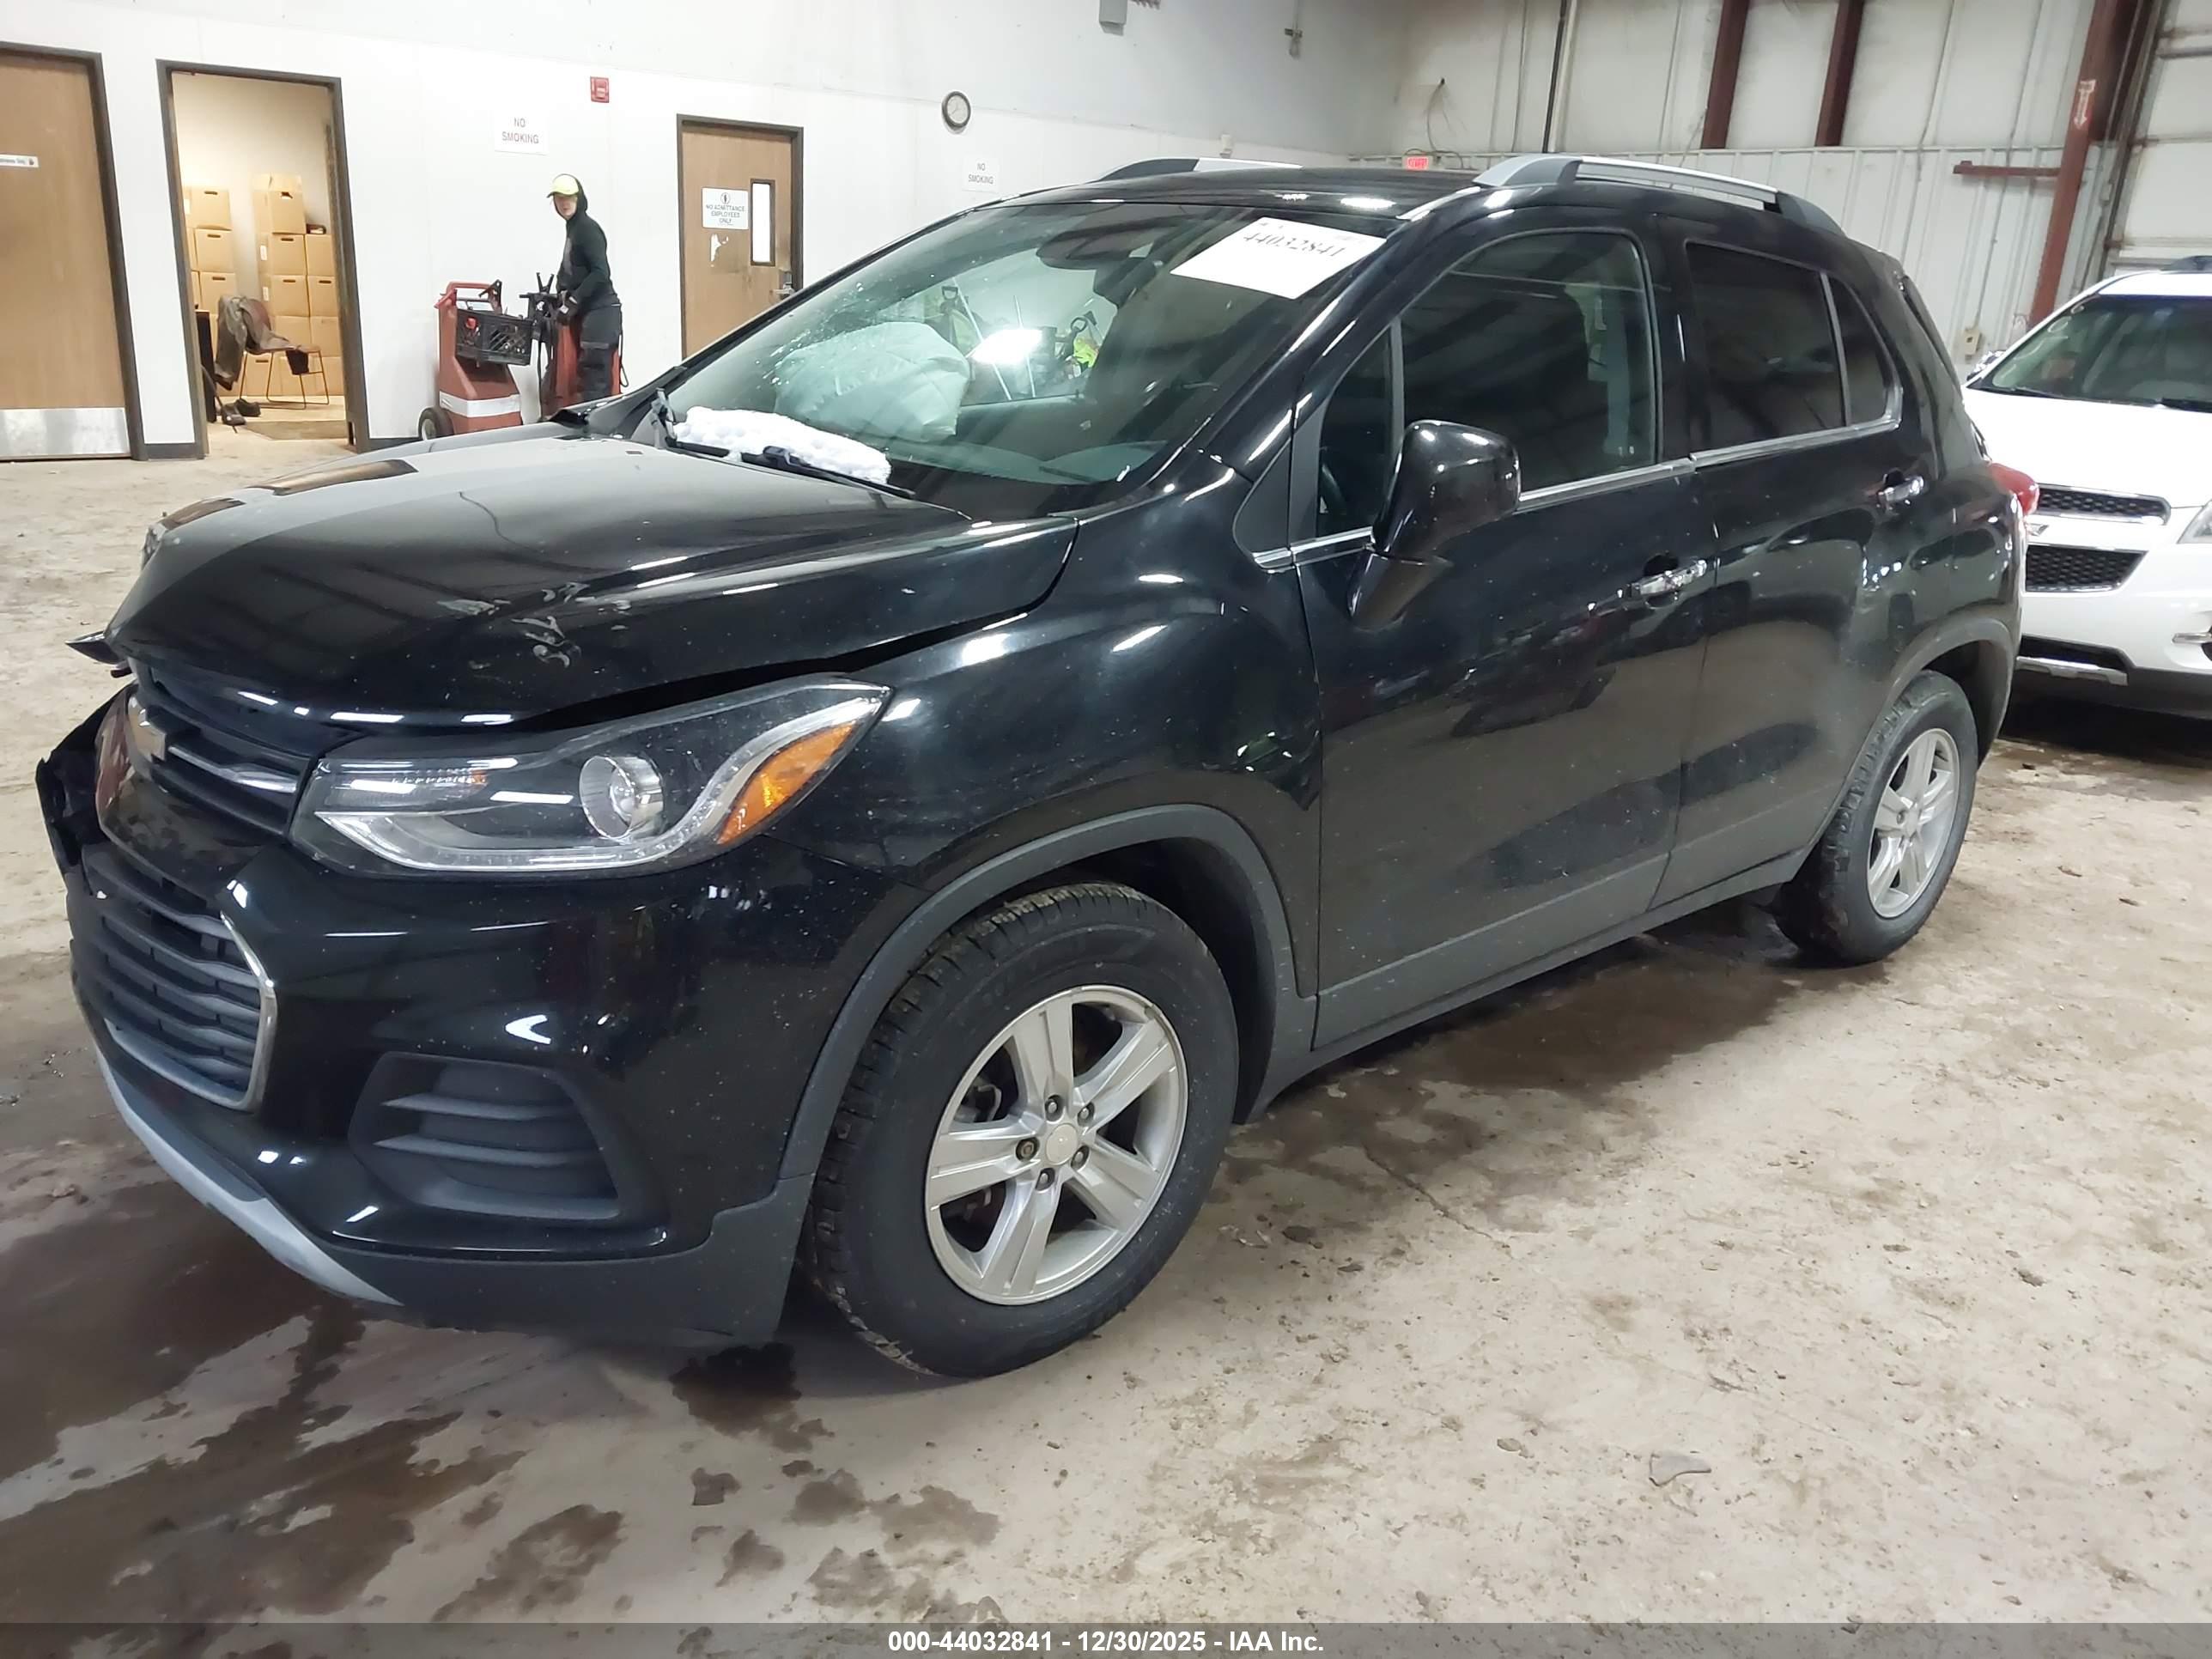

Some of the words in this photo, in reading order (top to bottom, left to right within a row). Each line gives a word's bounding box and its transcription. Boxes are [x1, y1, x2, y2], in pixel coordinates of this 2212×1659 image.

[514, 118, 526, 128] NO
[501, 131, 539, 143] SMOKING
[969, 174, 993, 184] SMOKING
[1243, 232, 1346, 257] 44032841
